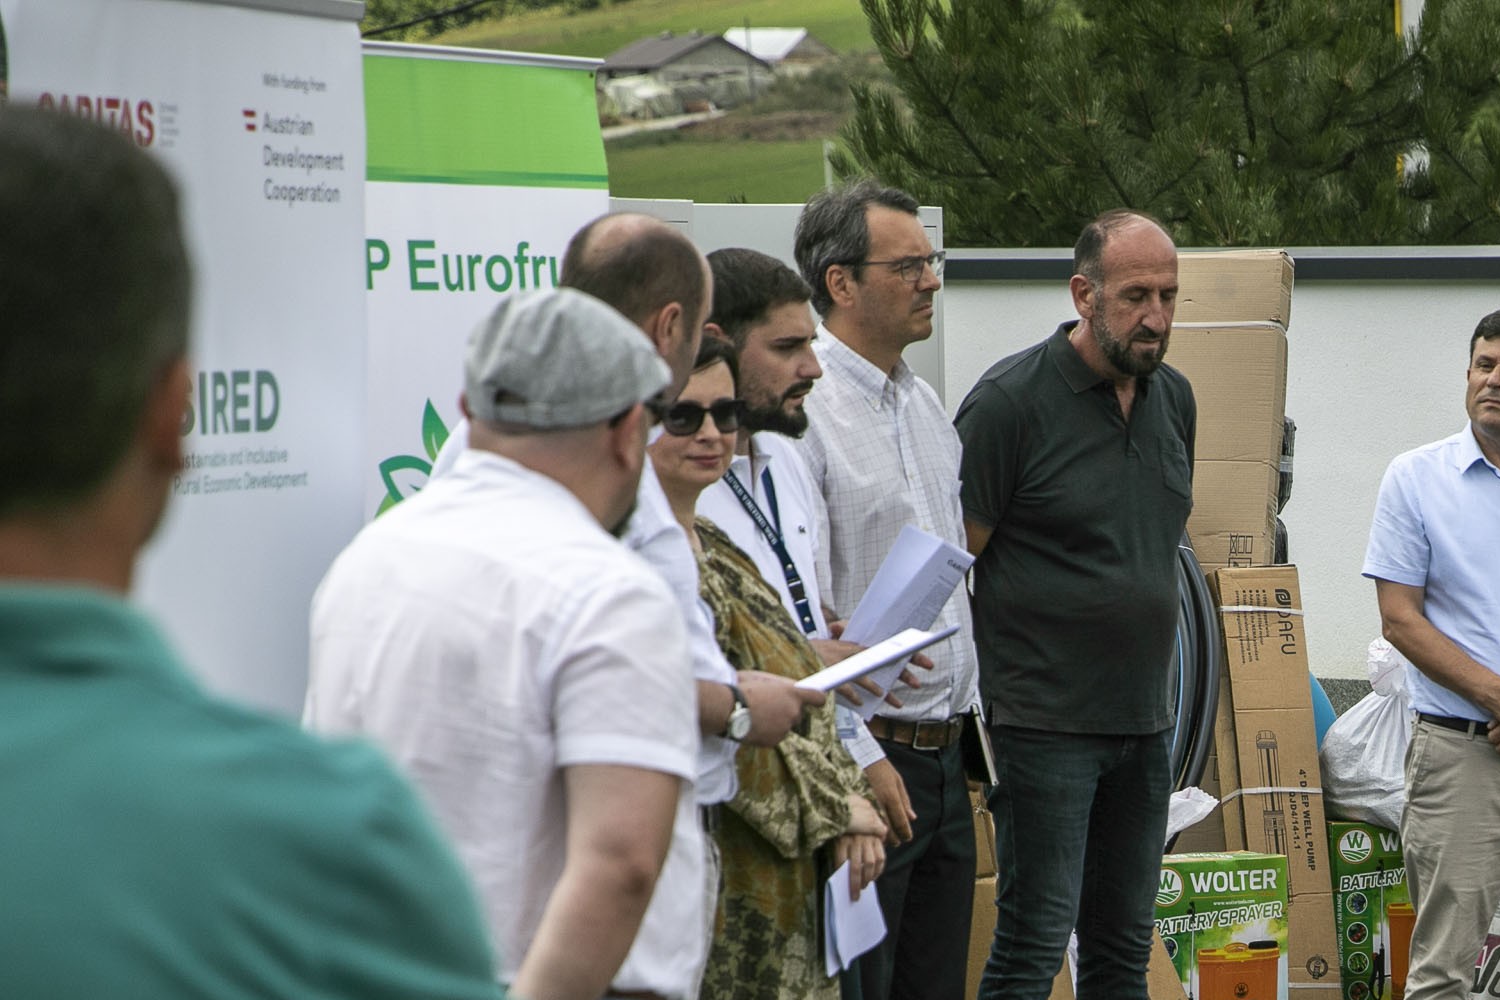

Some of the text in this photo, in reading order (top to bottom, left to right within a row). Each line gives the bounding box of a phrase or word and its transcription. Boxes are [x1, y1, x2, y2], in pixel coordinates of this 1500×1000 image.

[263, 112, 314, 135] Austrian
[263, 145, 345, 175] Development
[263, 178, 341, 207] Cooperation
[1299, 781, 1309, 808] DEP
[1303, 810, 1313, 839] WELL
[1305, 841, 1316, 871] PUMP
[1190, 868, 1277, 893] WOLTER
[1340, 868, 1406, 892] BATTERY
[1217, 901, 1283, 926] SPRAYER
